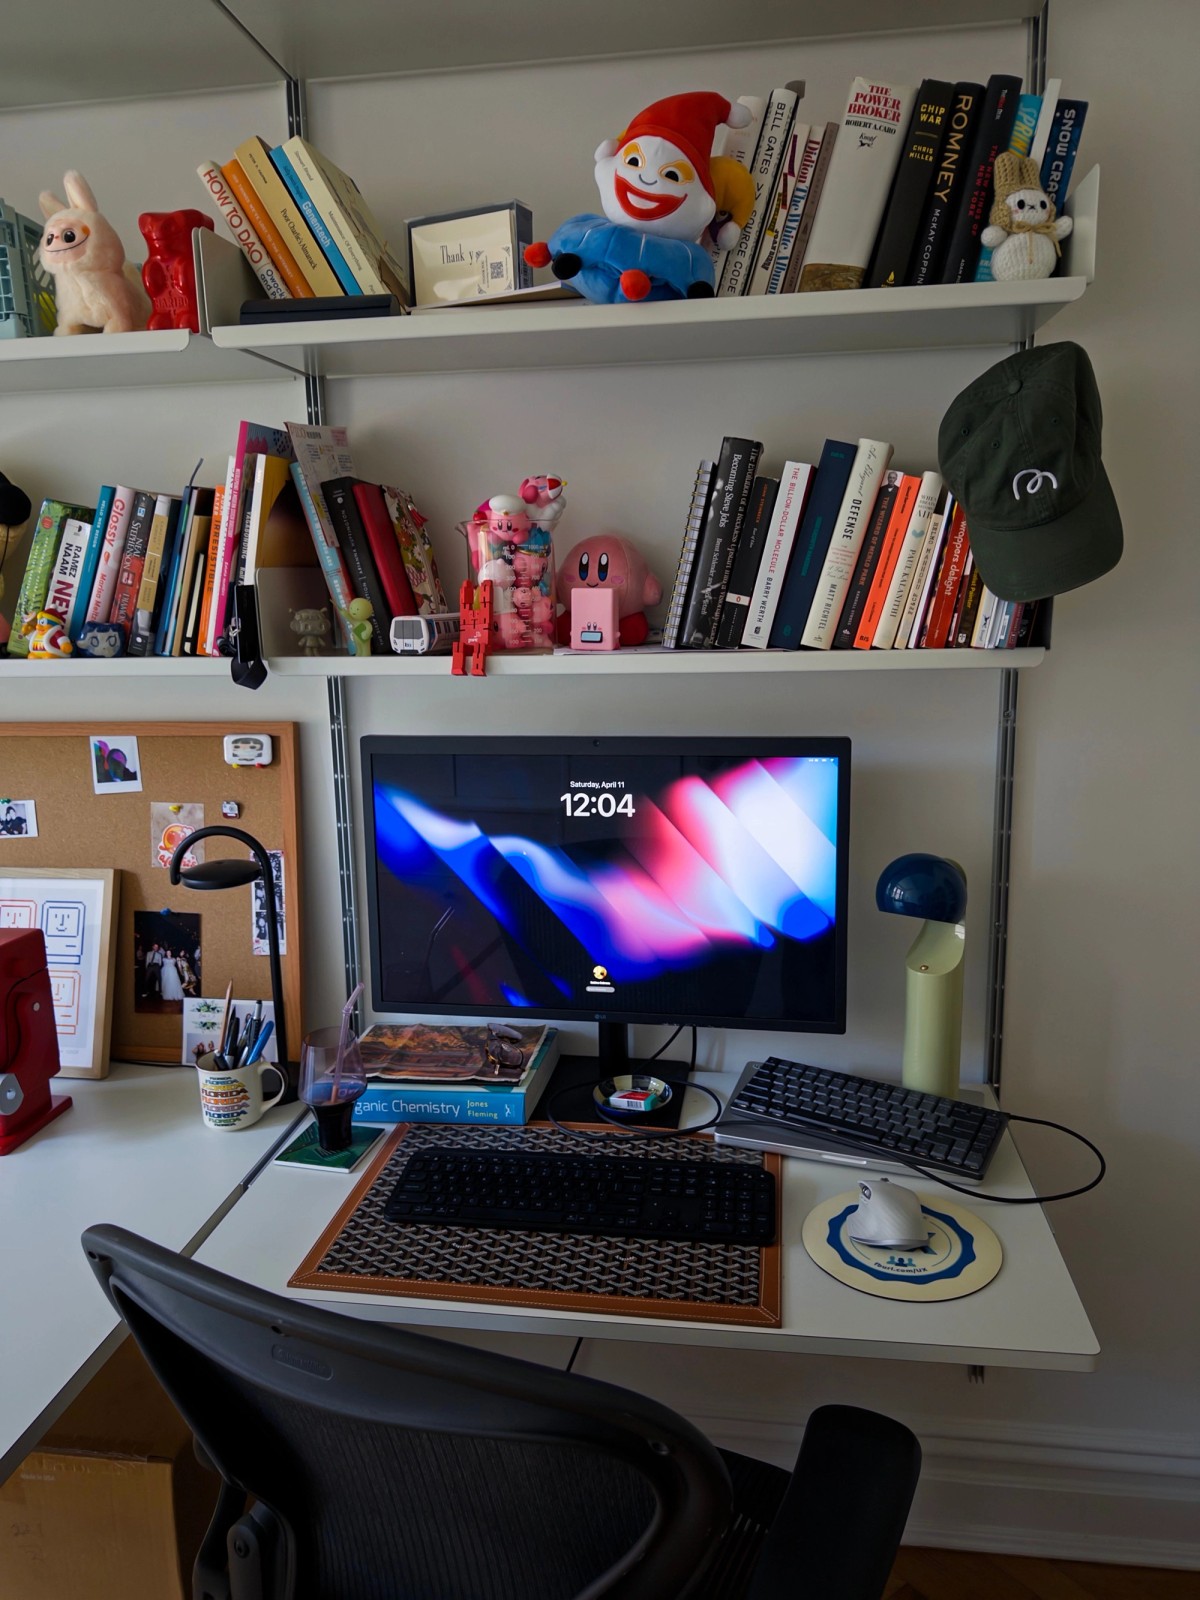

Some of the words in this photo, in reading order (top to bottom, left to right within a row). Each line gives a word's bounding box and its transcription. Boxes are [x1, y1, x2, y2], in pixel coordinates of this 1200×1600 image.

[855, 93, 900, 110] POWER
[869, 85, 892, 96] THE
[770, 102, 785, 132] BILL
[848, 104, 900, 123] BROKER
[920, 103, 946, 115] CHIP
[920, 112, 942, 125] WAR
[845, 119, 871, 131] ROBERT
[879, 124, 896, 135] CARO
[1057, 108, 1076, 156] SNOW
[759, 135, 776, 175] GATES
[798, 139, 820, 183] Didion
[908, 151, 934, 162] MILLER
[912, 144, 934, 154] CHRIS
[933, 94, 972, 203] ROMNEY
[988, 144, 998, 162] THE
[974, 164, 985, 185] NEW
[982, 166, 992, 188] NEW
[1046, 160, 1064, 202] CRAS
[791, 185, 809, 212] The
[966, 190, 979, 217] YORK
[974, 191, 986, 220] KINGS
[203, 168, 233, 208] HOW
[223, 206, 244, 229] TO
[237, 229, 263, 264] DAO
[301, 200, 331, 248] Genentech
[925, 207, 941, 241] McKAY
[279, 208, 292, 223] Poor
[286, 220, 305, 244] Charlie's
[298, 242, 319, 269] Almanack
[736, 208, 757, 257] SOURCE
[782, 212, 801, 250] White
[970, 223, 978, 236] OF
[440, 244, 465, 264] Thank
[917, 244, 932, 285] COPPIN
[258, 272, 273, 291] and
[726, 260, 742, 293] CODE
[768, 255, 790, 295] Album
[725, 453, 742, 491] Becoming
[791, 466, 800, 480] THE
[855, 463, 874, 497] Elegant
[721, 491, 733, 511] Steve
[777, 482, 796, 537] BILLION-DOLLAR
[880, 495, 889, 508] THE
[104, 498, 126, 547] Glossy
[717, 511, 729, 528] Jobs
[842, 498, 862, 540] DEFENSE
[873, 509, 885, 535] WIZARD
[122, 520, 141, 570] STEPHENSON
[132, 537, 143, 557] NEAL
[242, 511, 252, 559] VAGABONDING
[870, 536, 878, 545] OF
[949, 520, 968, 562] wrappers
[58, 542, 73, 575] NAAM
[68, 545, 83, 578] RAMEZ
[207, 520, 222, 592] IRRESISTIBLE
[768, 539, 782, 573] MOLECULE
[862, 544, 875, 570] MENLO
[903, 548, 916, 571] PAUL
[96, 573, 107, 598] Marisa
[762, 577, 773, 598] BARRY
[858, 570, 868, 585] PARK
[941, 563, 960, 596] delight
[50, 579, 74, 630] NEX
[826, 583, 837, 601] MATT
[889, 571, 908, 618] KALANITHI
[116, 593, 130, 624] DIAMON
[755, 599, 767, 622] WERTH
[817, 602, 831, 630] RICHTEL
[560, 793, 635, 817] 12:04
[202, 1082, 245, 1091] FLORIDA
[202, 1088, 248, 1097] FLORIDA
[202, 1094, 250, 1105] FLORIDA
[204, 1102, 249, 1111] FLORIDA
[206, 1110, 248, 1118] FLORIDA
[392, 1100, 460, 1117] Chemistry
[467, 1100, 488, 1108] Jones
[468, 1110, 498, 1120] Fleming
